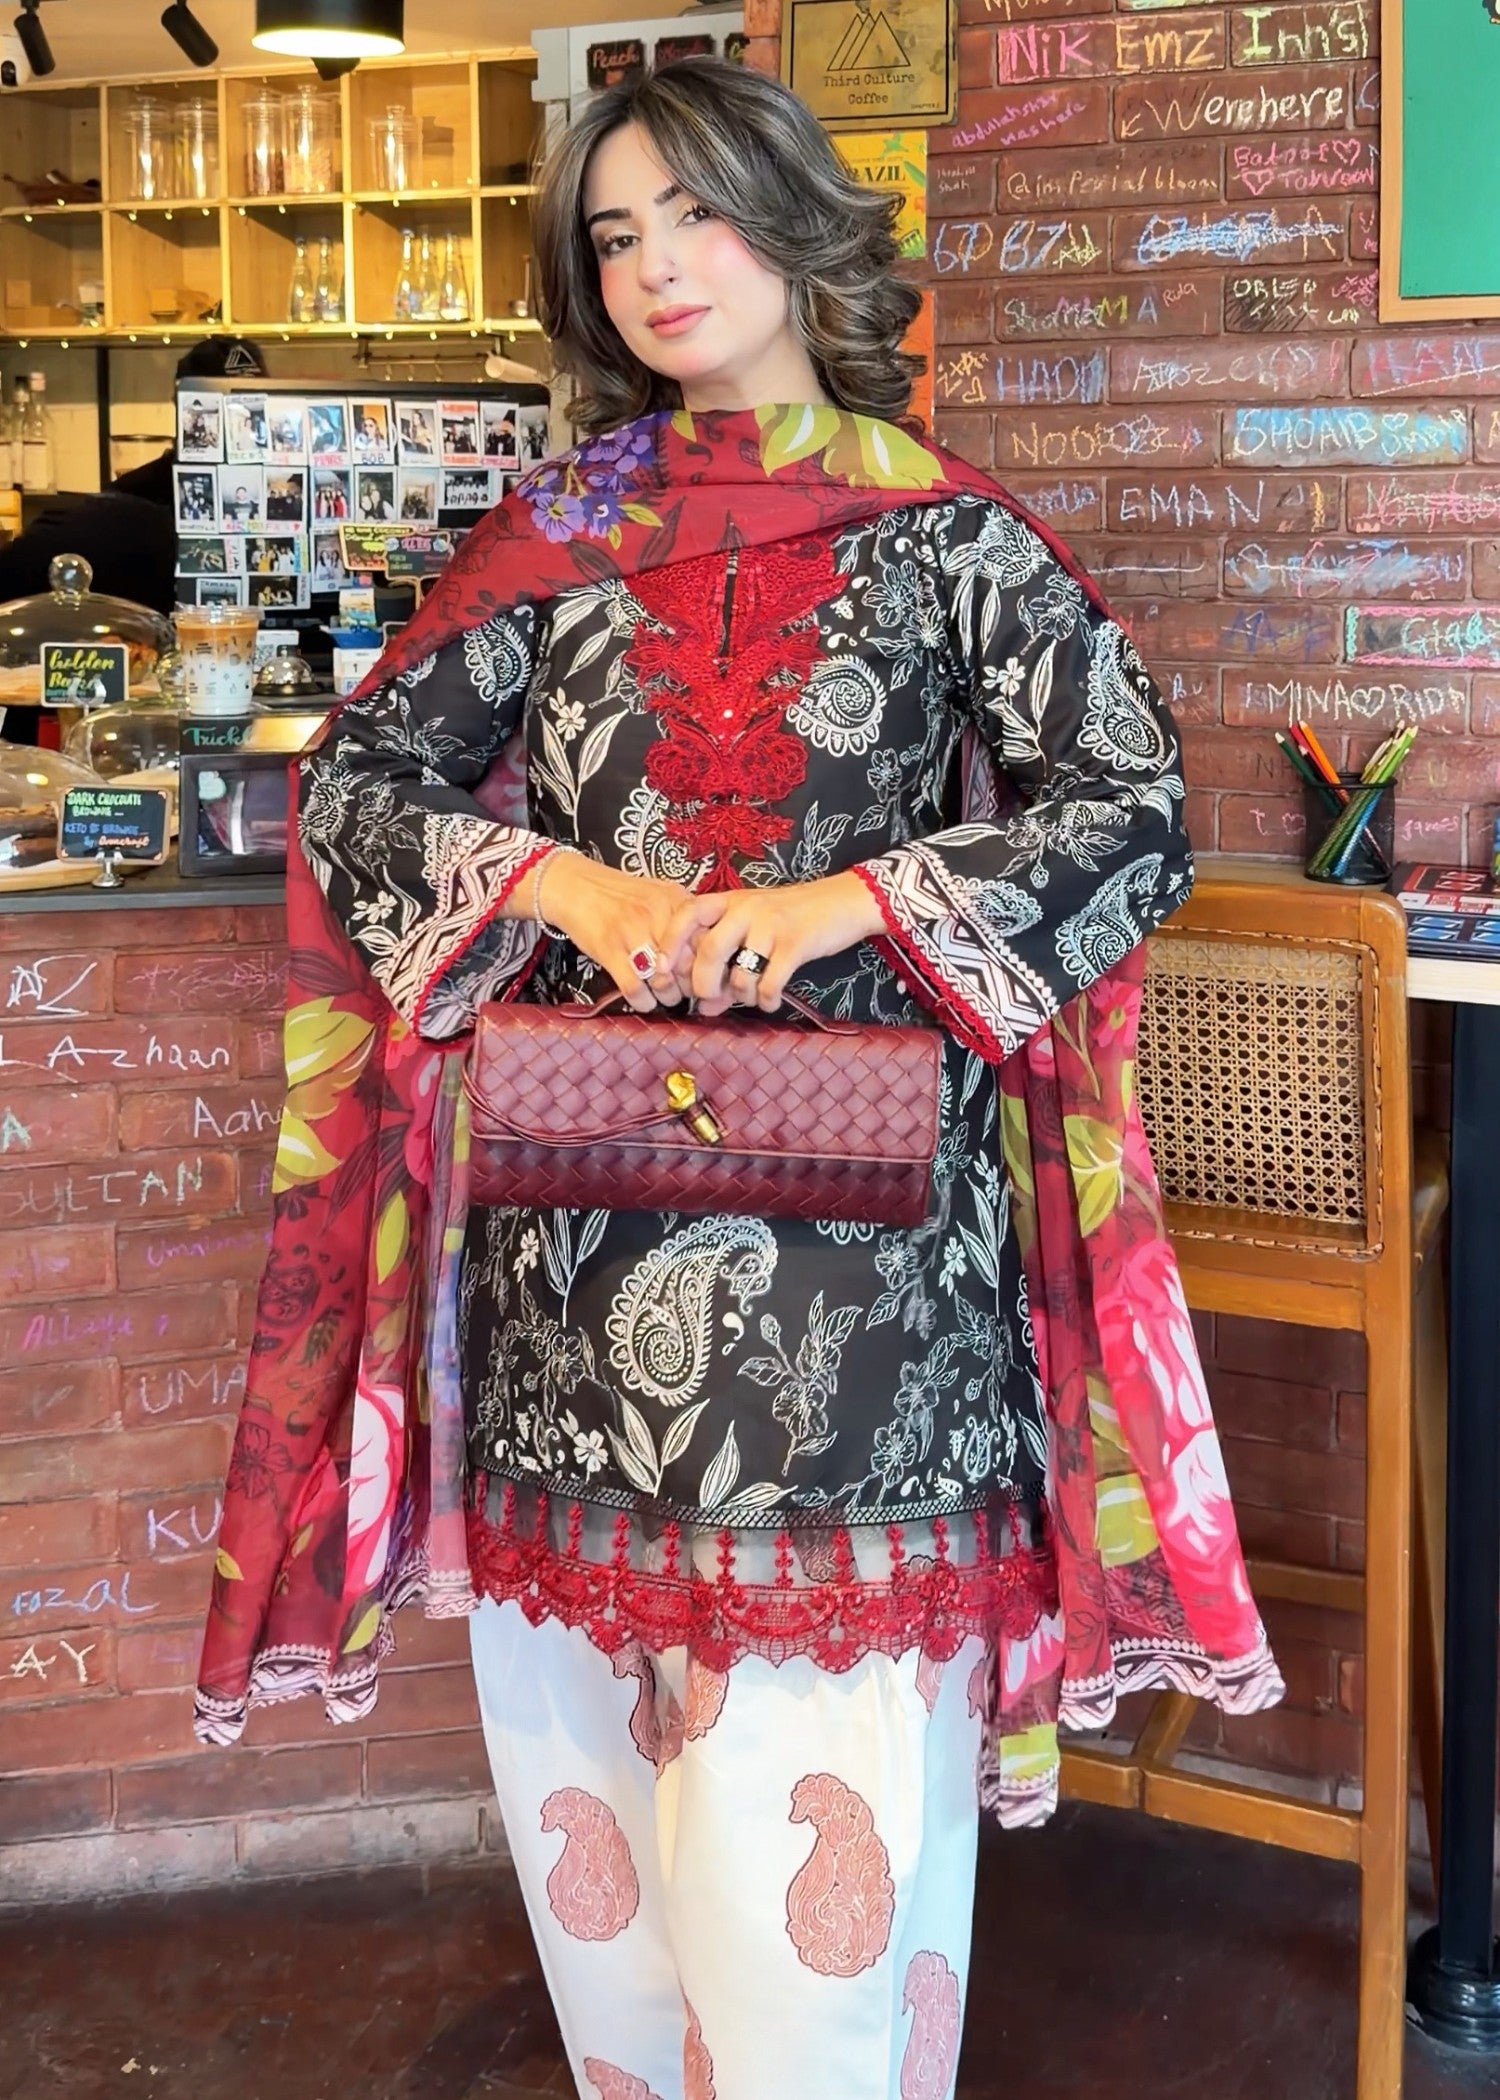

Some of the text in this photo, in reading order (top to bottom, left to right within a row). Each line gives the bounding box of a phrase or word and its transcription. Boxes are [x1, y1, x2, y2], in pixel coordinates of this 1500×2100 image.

[593, 44, 640, 69] Peach
[823, 73, 916, 87] Third Culture
[848, 94, 889, 105] Coffee
[1120, 479, 1265, 528] EMAN
[67, 790, 95, 806] DARK
